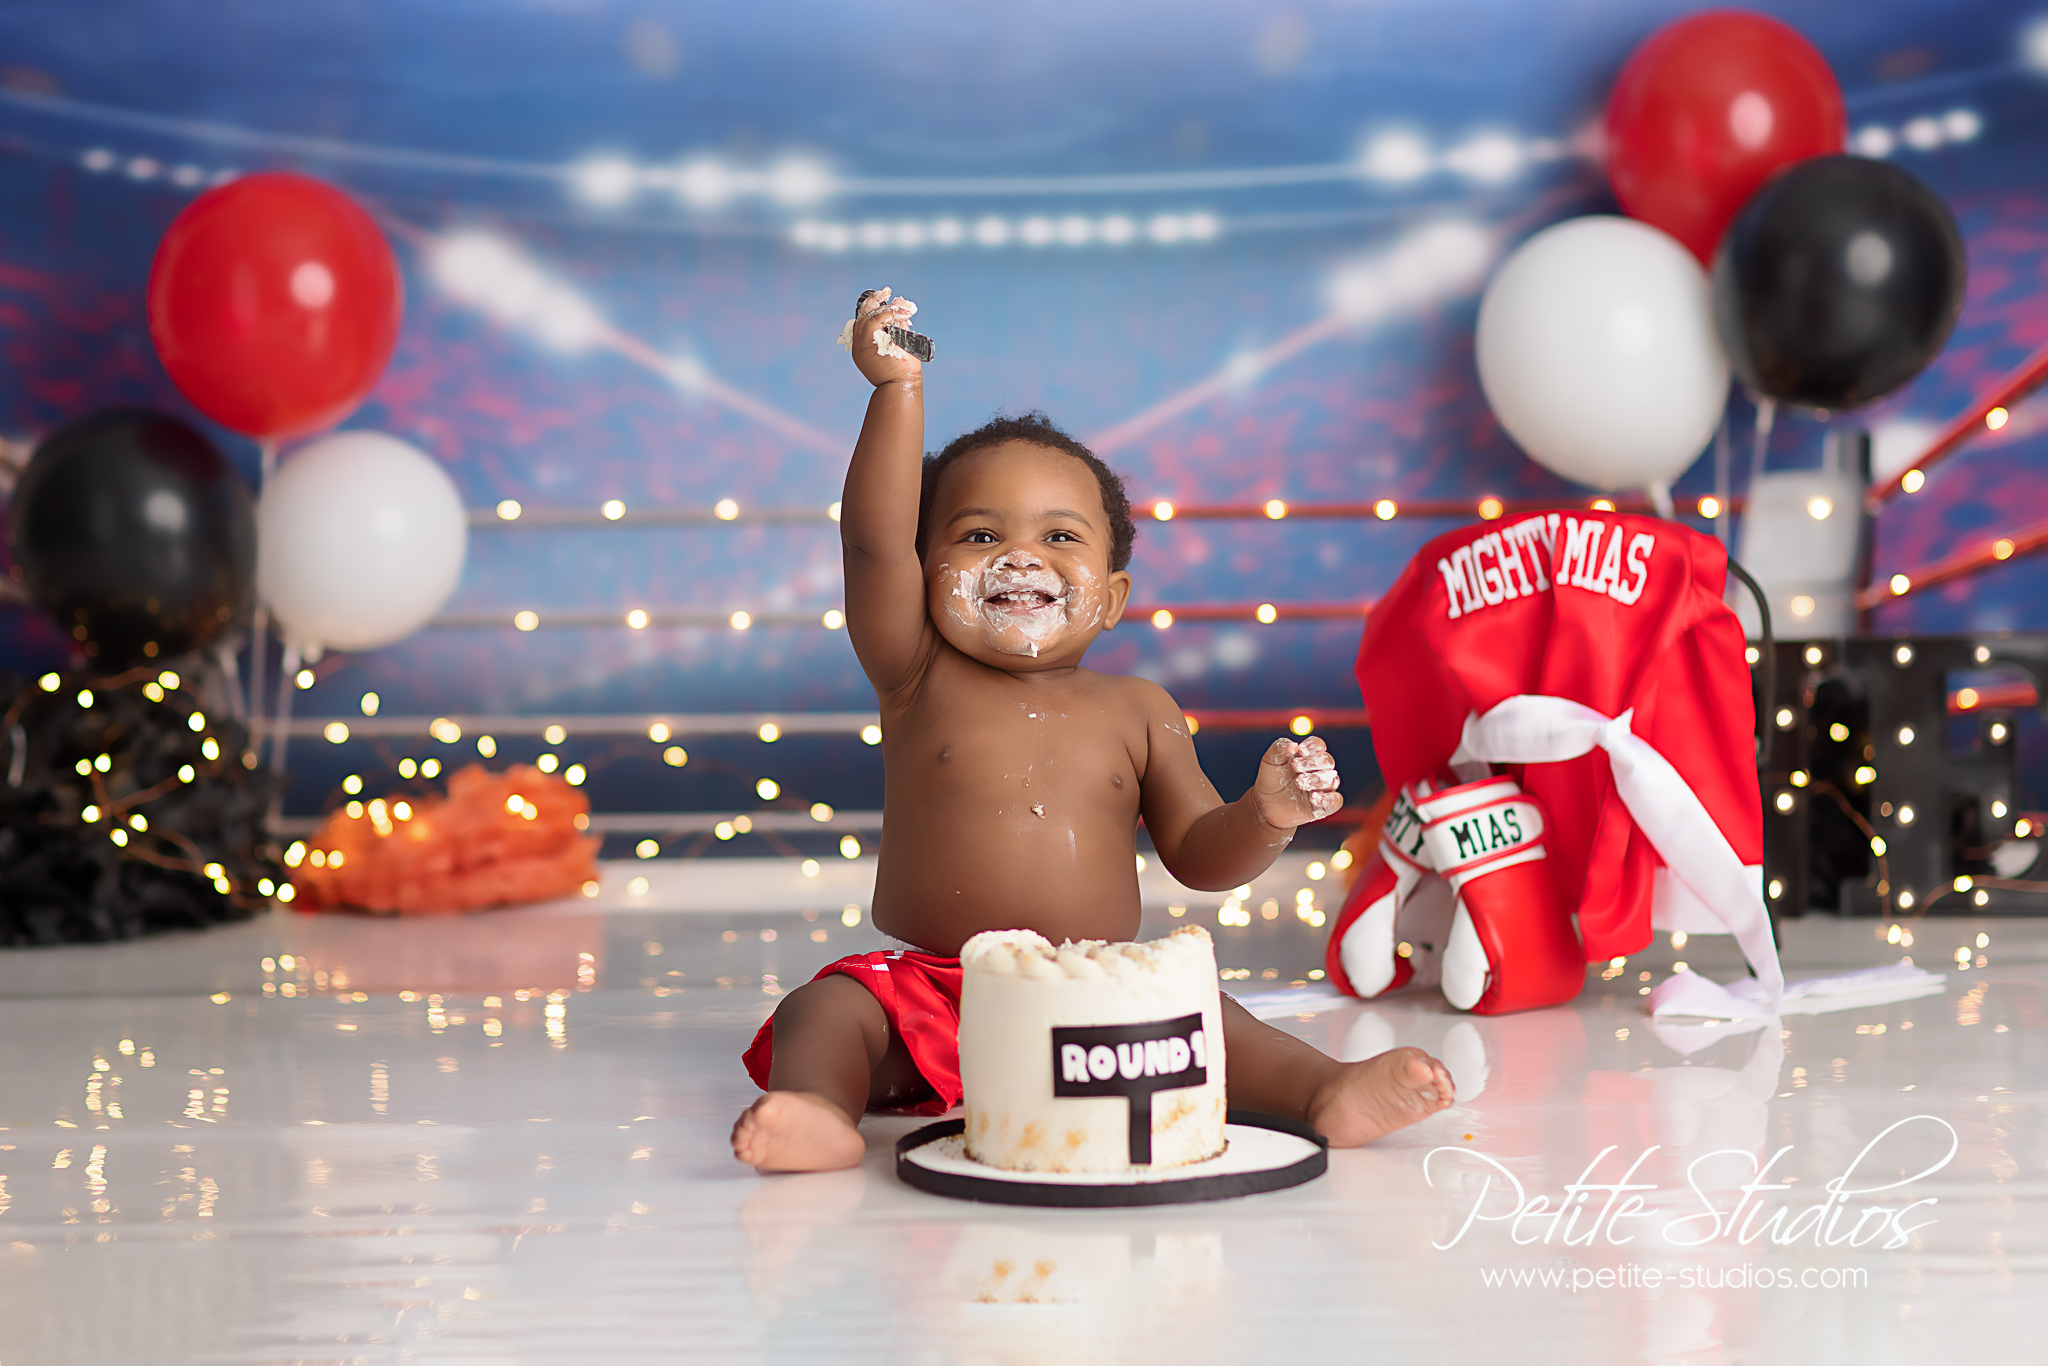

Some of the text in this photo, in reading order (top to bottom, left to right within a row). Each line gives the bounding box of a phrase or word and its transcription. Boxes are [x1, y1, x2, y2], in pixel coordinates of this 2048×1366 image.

[1438, 513, 1655, 619] MIGHTY MIAS
[1450, 807, 1522, 859] MIAS
[1061, 1036, 1190, 1083] ROUND
